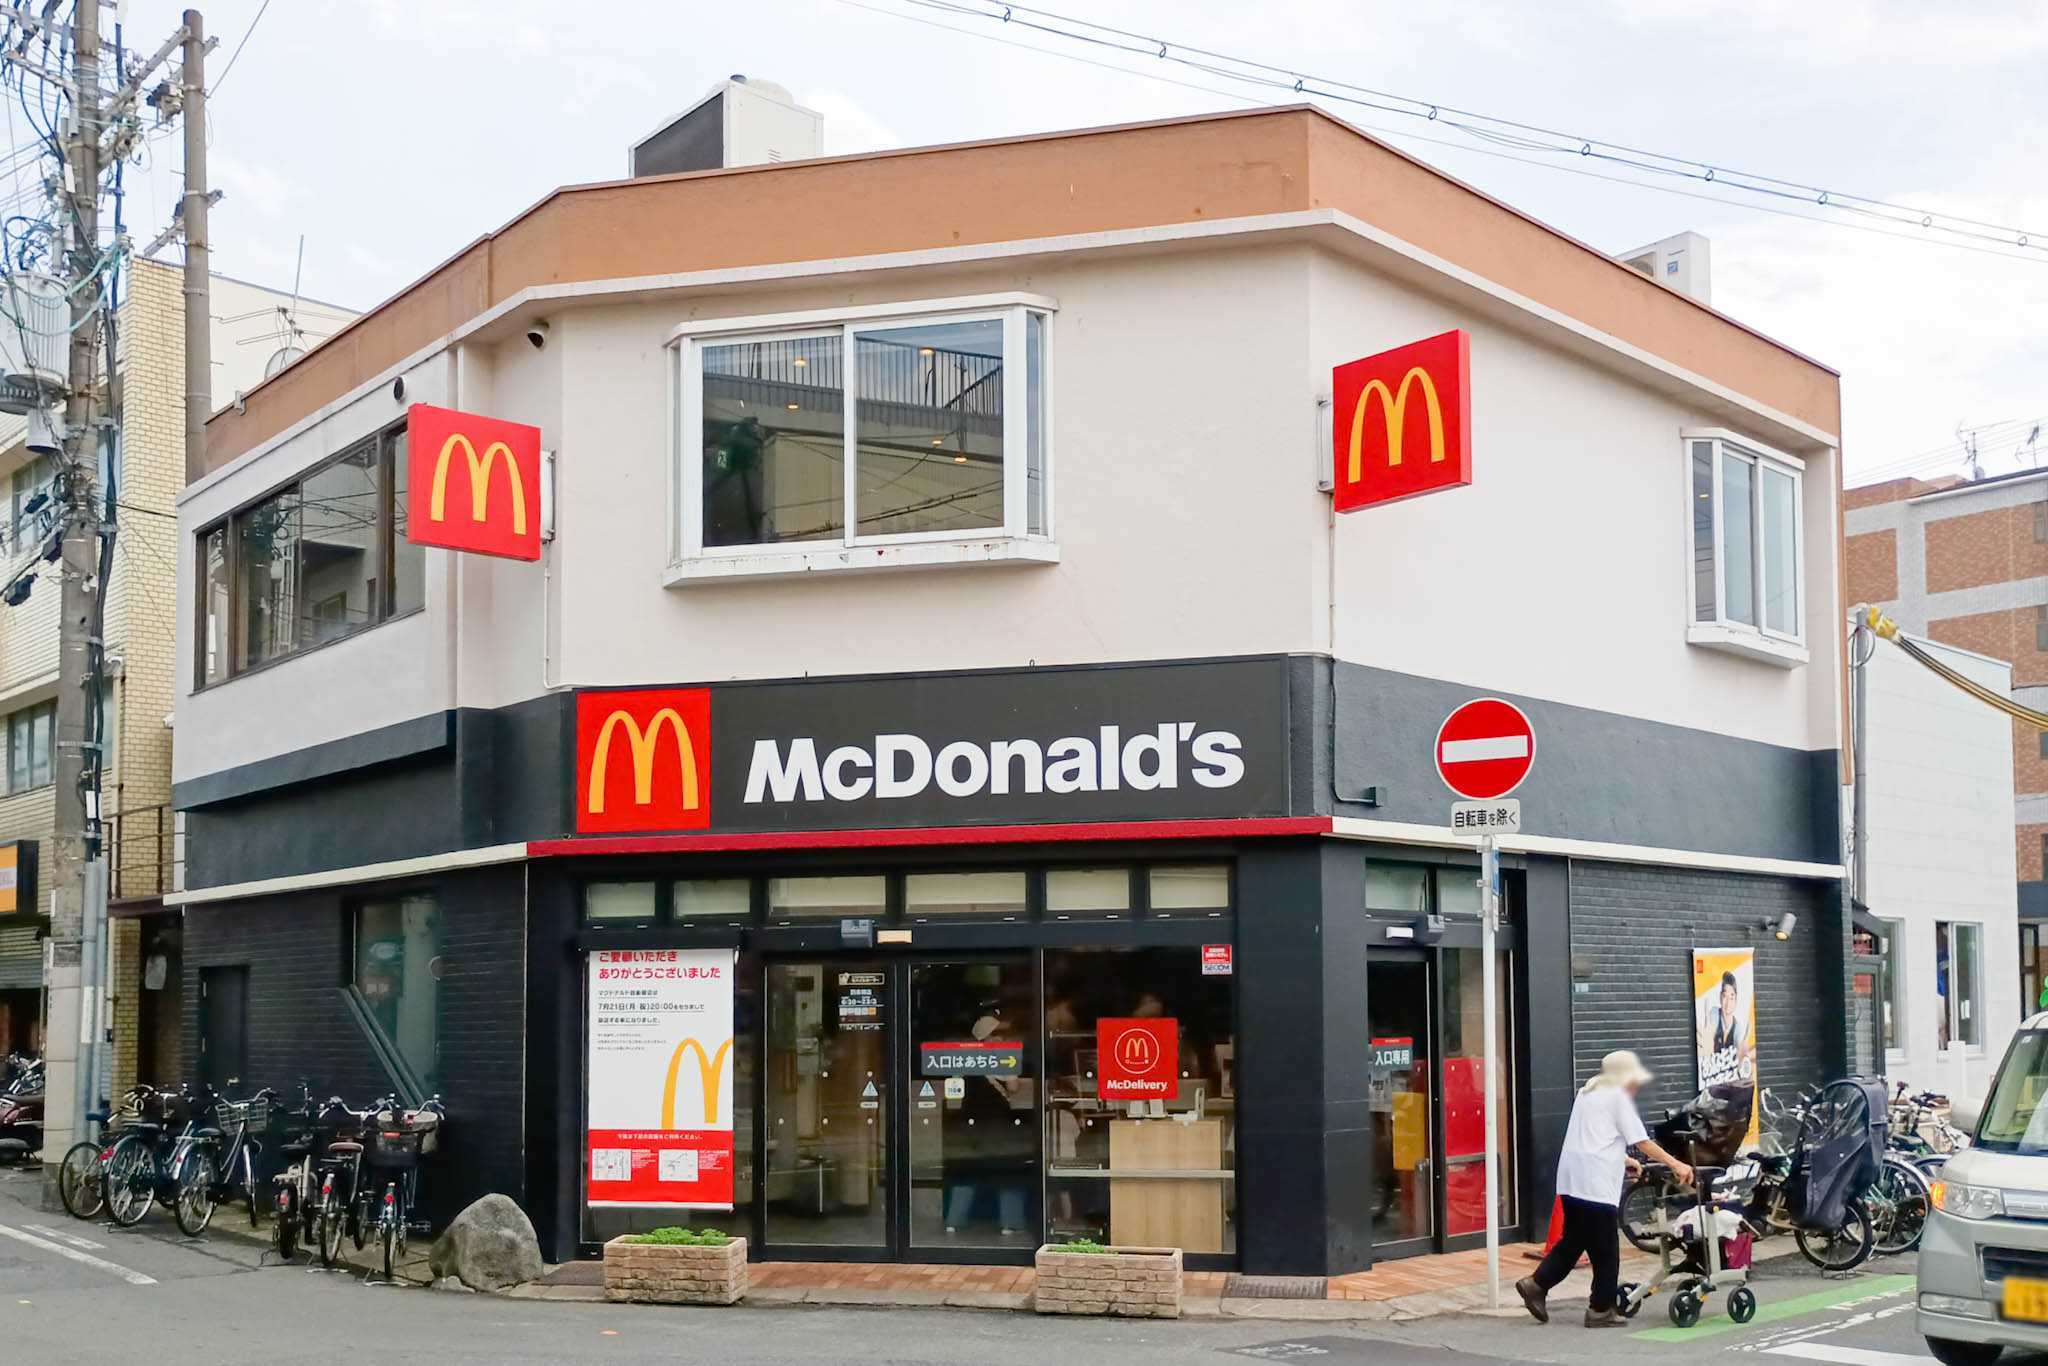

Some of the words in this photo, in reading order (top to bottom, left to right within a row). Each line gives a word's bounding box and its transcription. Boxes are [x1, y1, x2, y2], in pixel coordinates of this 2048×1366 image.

[743, 722, 1246, 804] McDonald's
[1454, 808, 1516, 828] 自転車を除く
[599, 967, 721, 980] ありがとうございました
[927, 1055, 999, 1069] 入口はあちら
[1375, 1050, 1410, 1066] 入口専用
[1107, 1079, 1167, 1091] McDelivery
